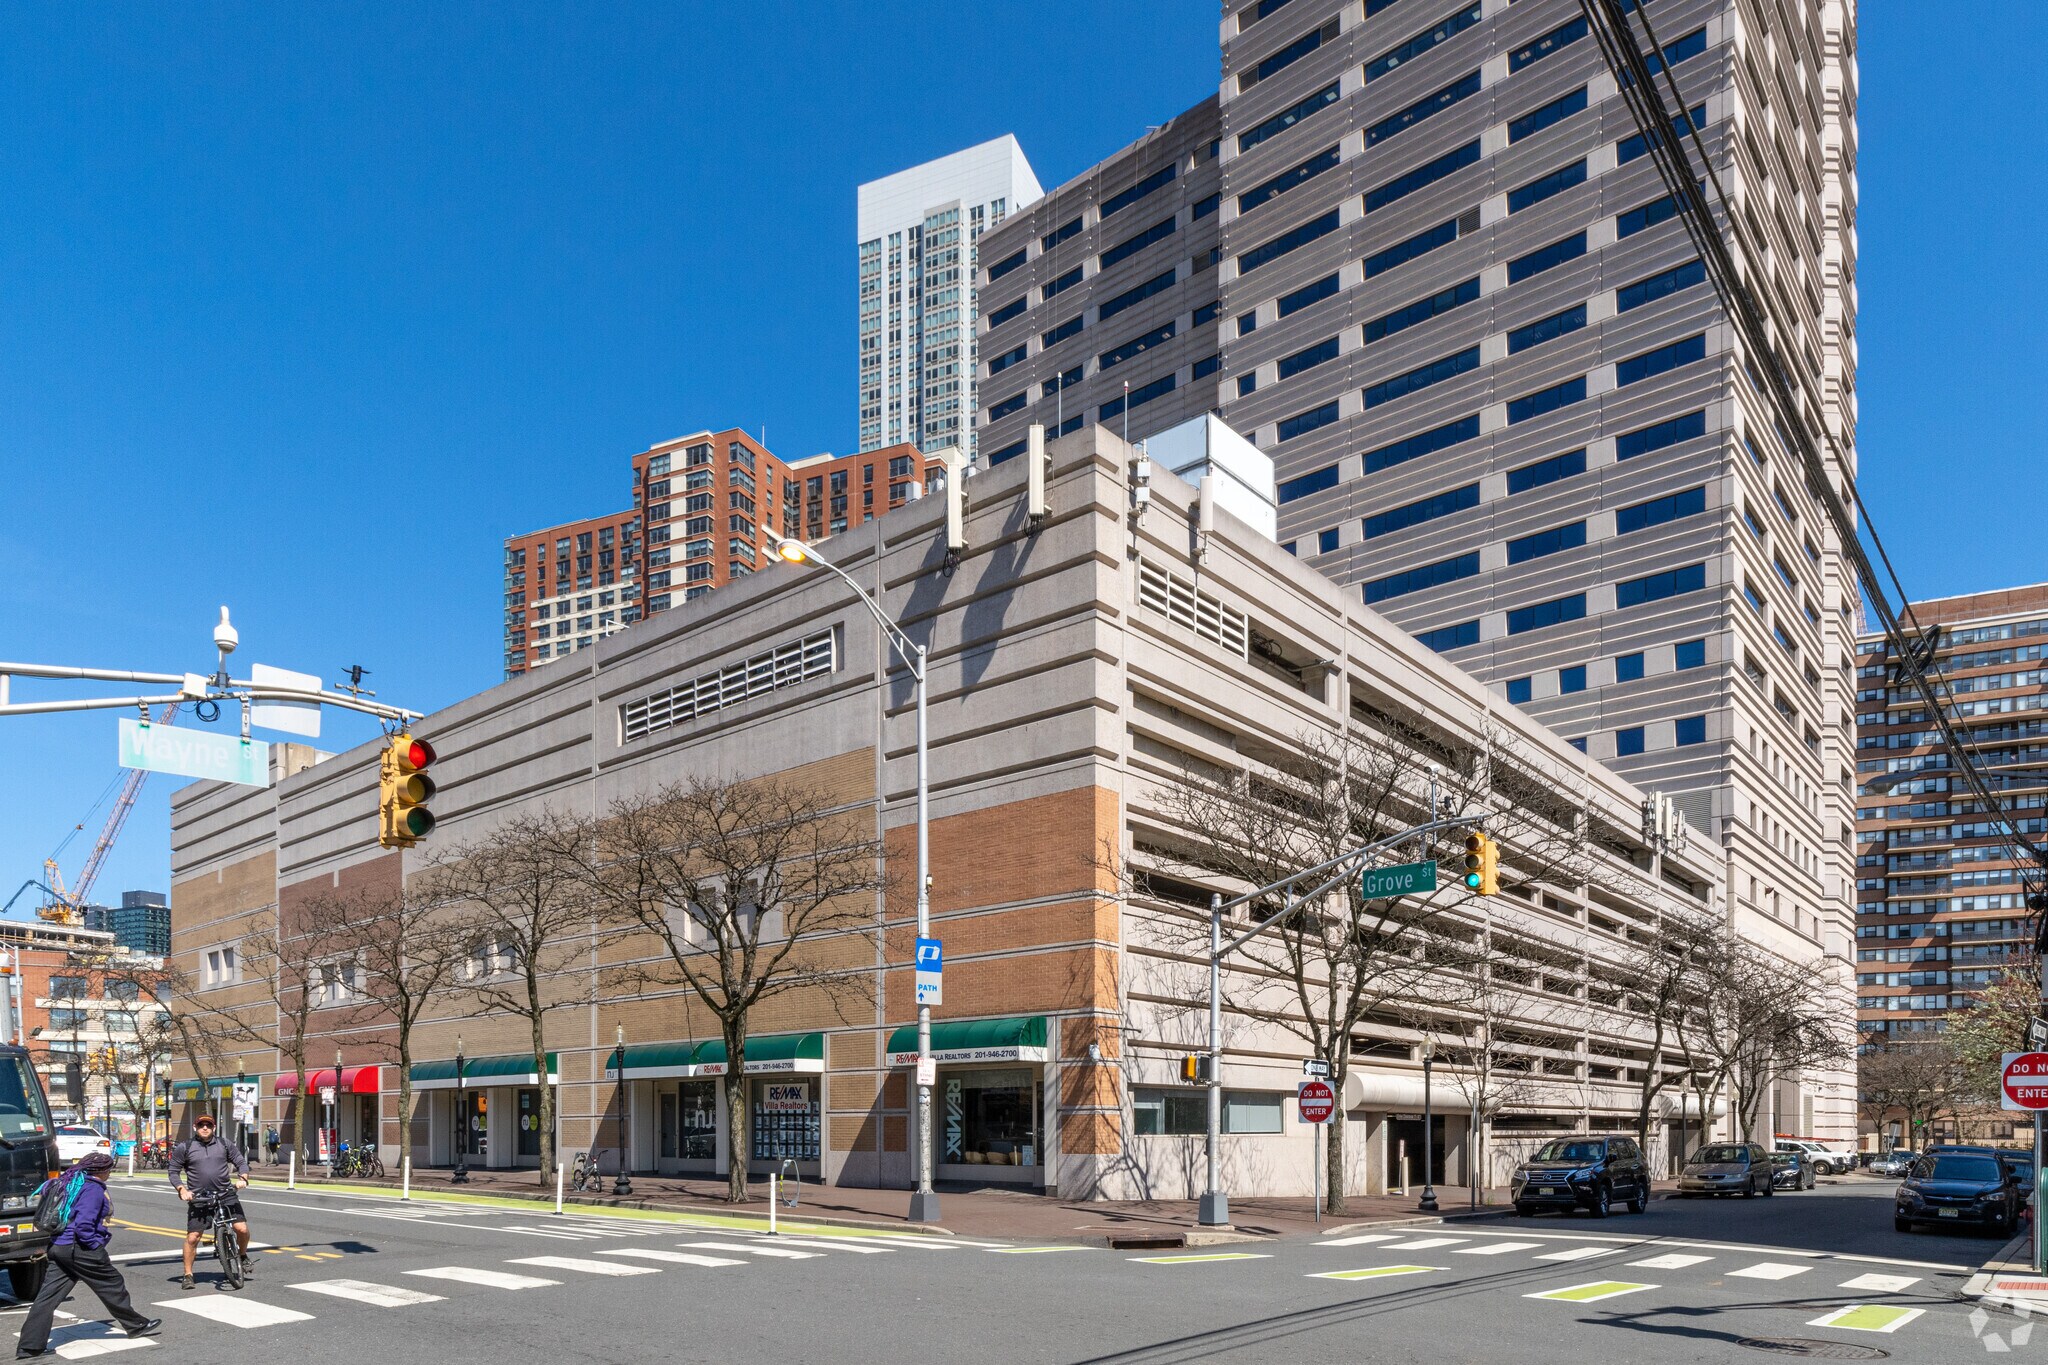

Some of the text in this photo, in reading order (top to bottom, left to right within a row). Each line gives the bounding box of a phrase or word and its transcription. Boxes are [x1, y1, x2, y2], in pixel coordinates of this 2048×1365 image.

[131, 727, 259, 769] Wayne St
[1367, 867, 1431, 893] Grove St
[918, 983, 937, 991] PATH
[945, 1053, 971, 1061] REALTORS
[974, 1049, 1017, 1059] 201-946-2700
[2012, 1064, 2029, 1073] DO
[769, 1085, 802, 1101] RE/MAX
[764, 1101, 808, 1110] Villa Realtors
